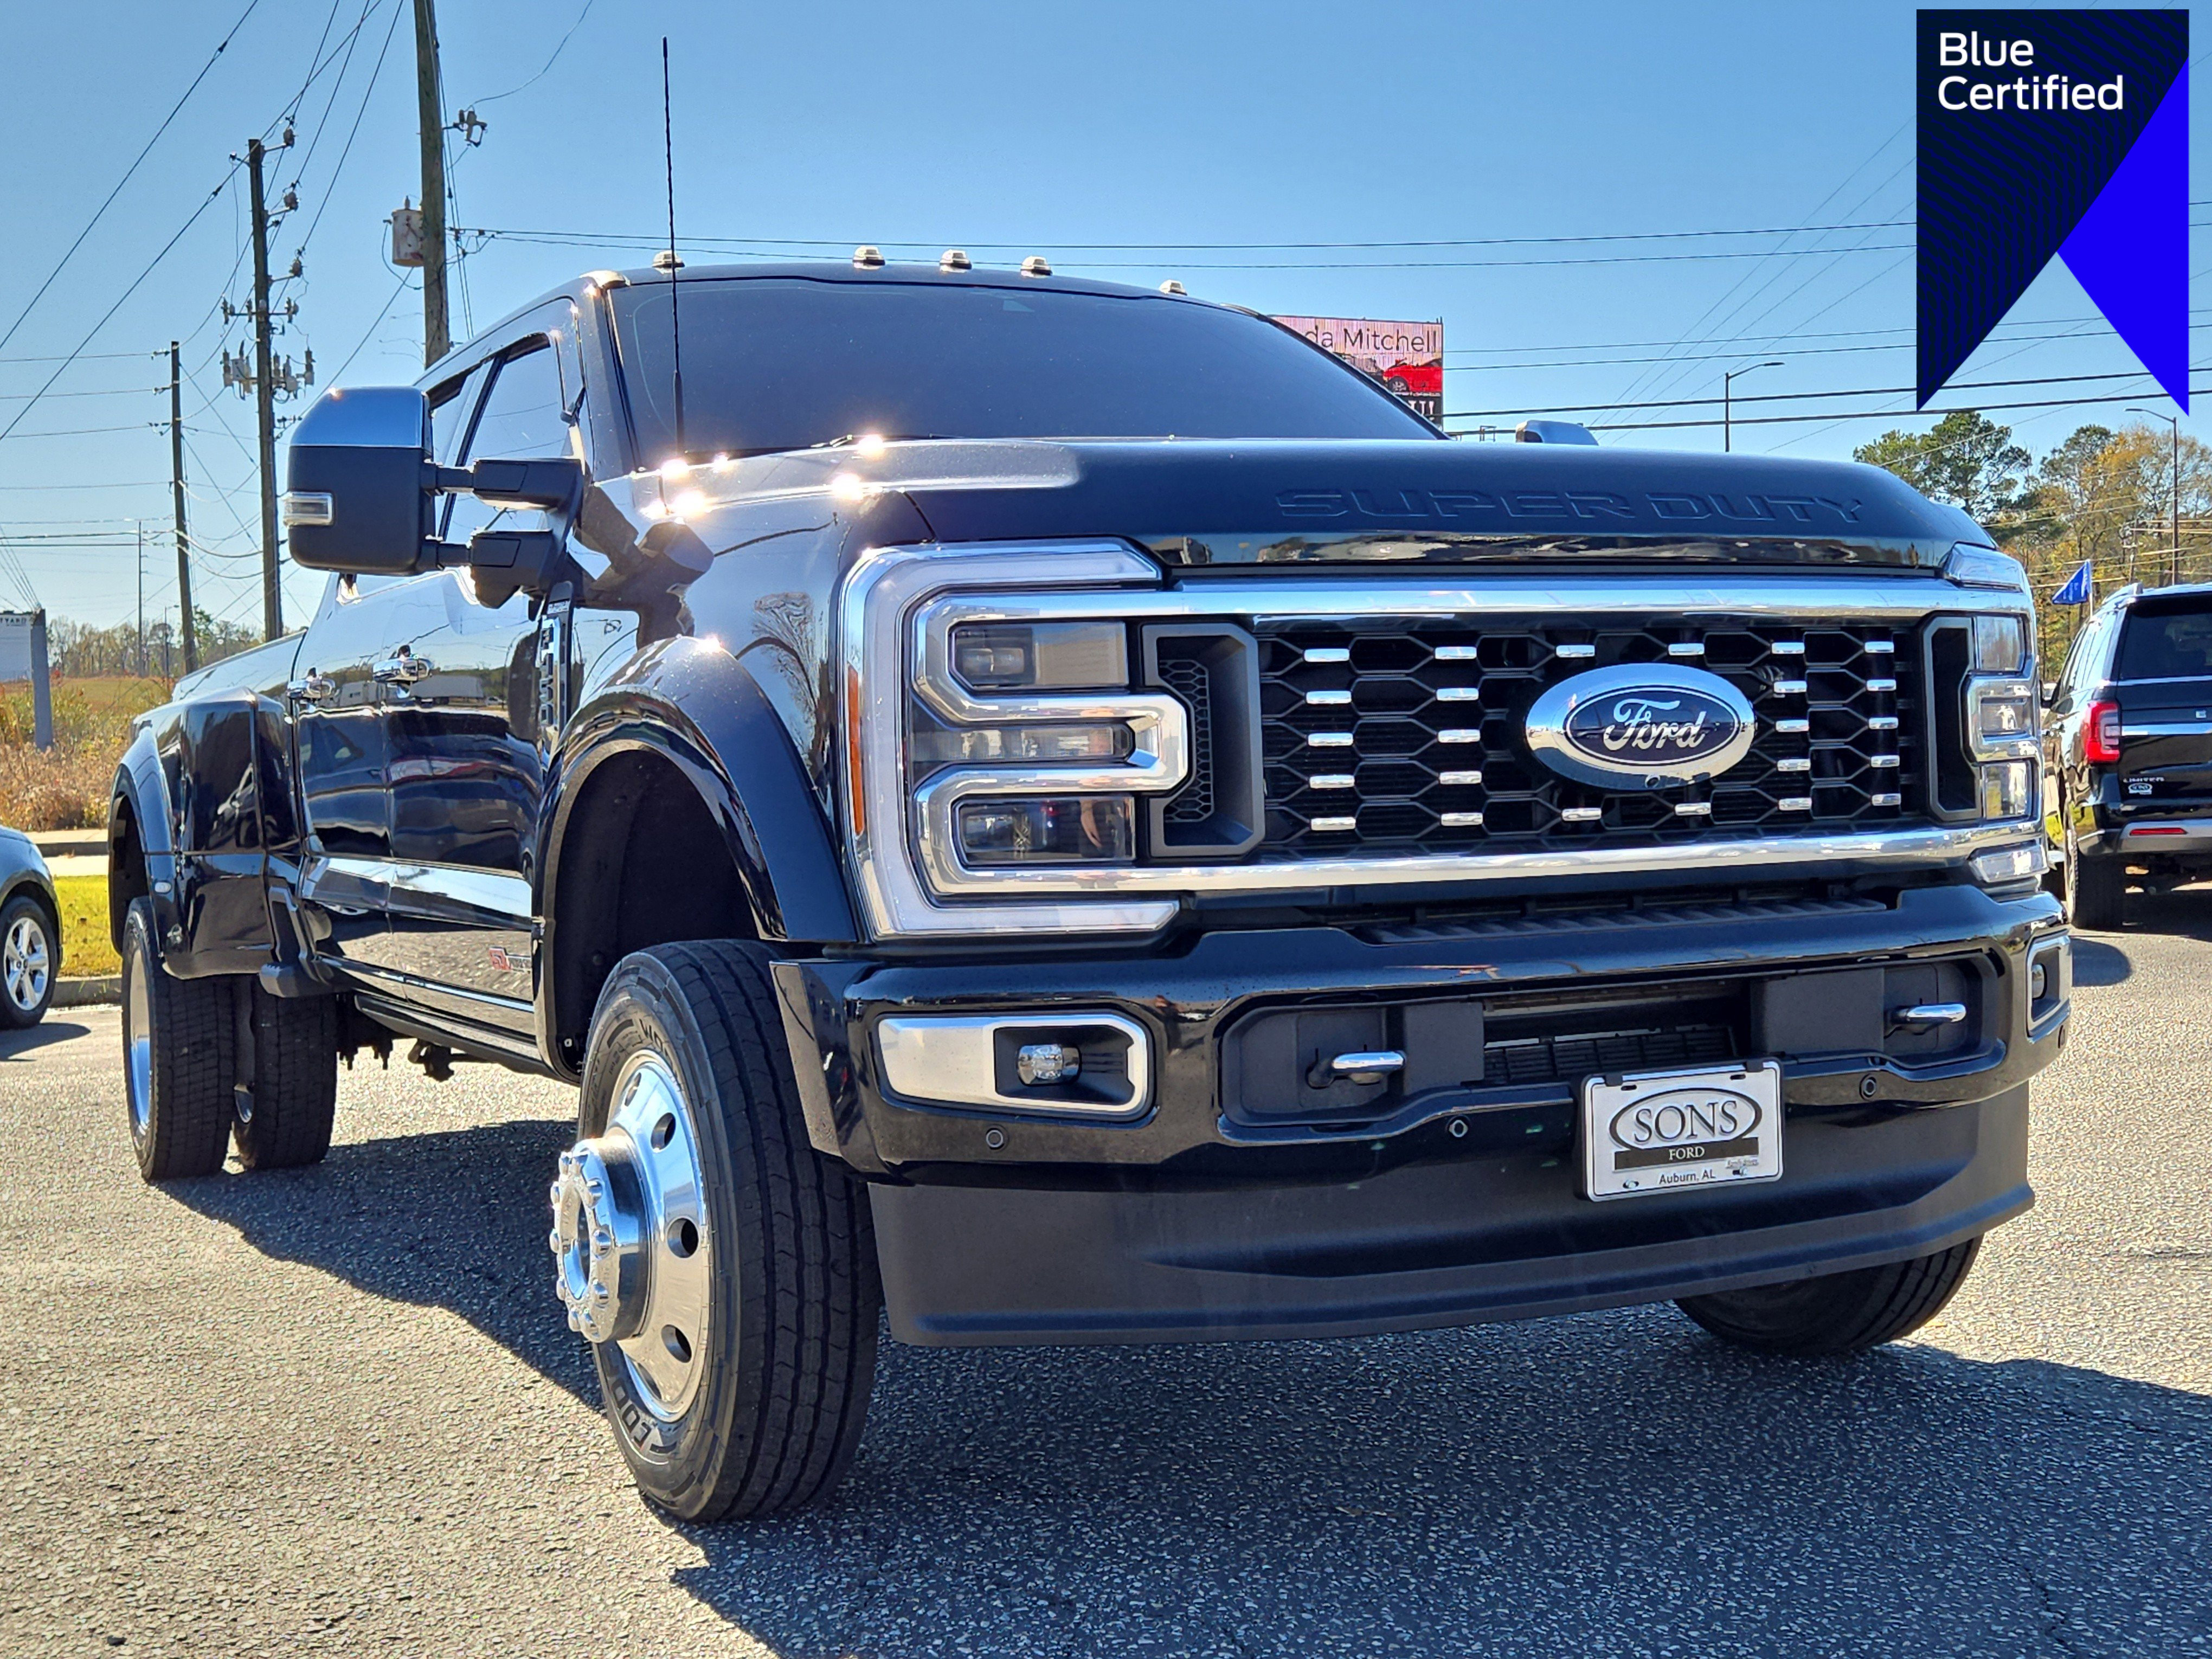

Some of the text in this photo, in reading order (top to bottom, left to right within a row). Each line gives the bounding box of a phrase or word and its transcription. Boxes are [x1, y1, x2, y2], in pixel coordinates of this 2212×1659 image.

[1343, 328, 1437, 352] Mitchell
[1275, 489, 1862, 523] SUPER DUTY
[1603, 698, 1707, 750] Ford
[1634, 1100, 1738, 1143] SONS
[1668, 1146, 1705, 1161] FORD
[1659, 1169, 1716, 1184] Auburn, AL
